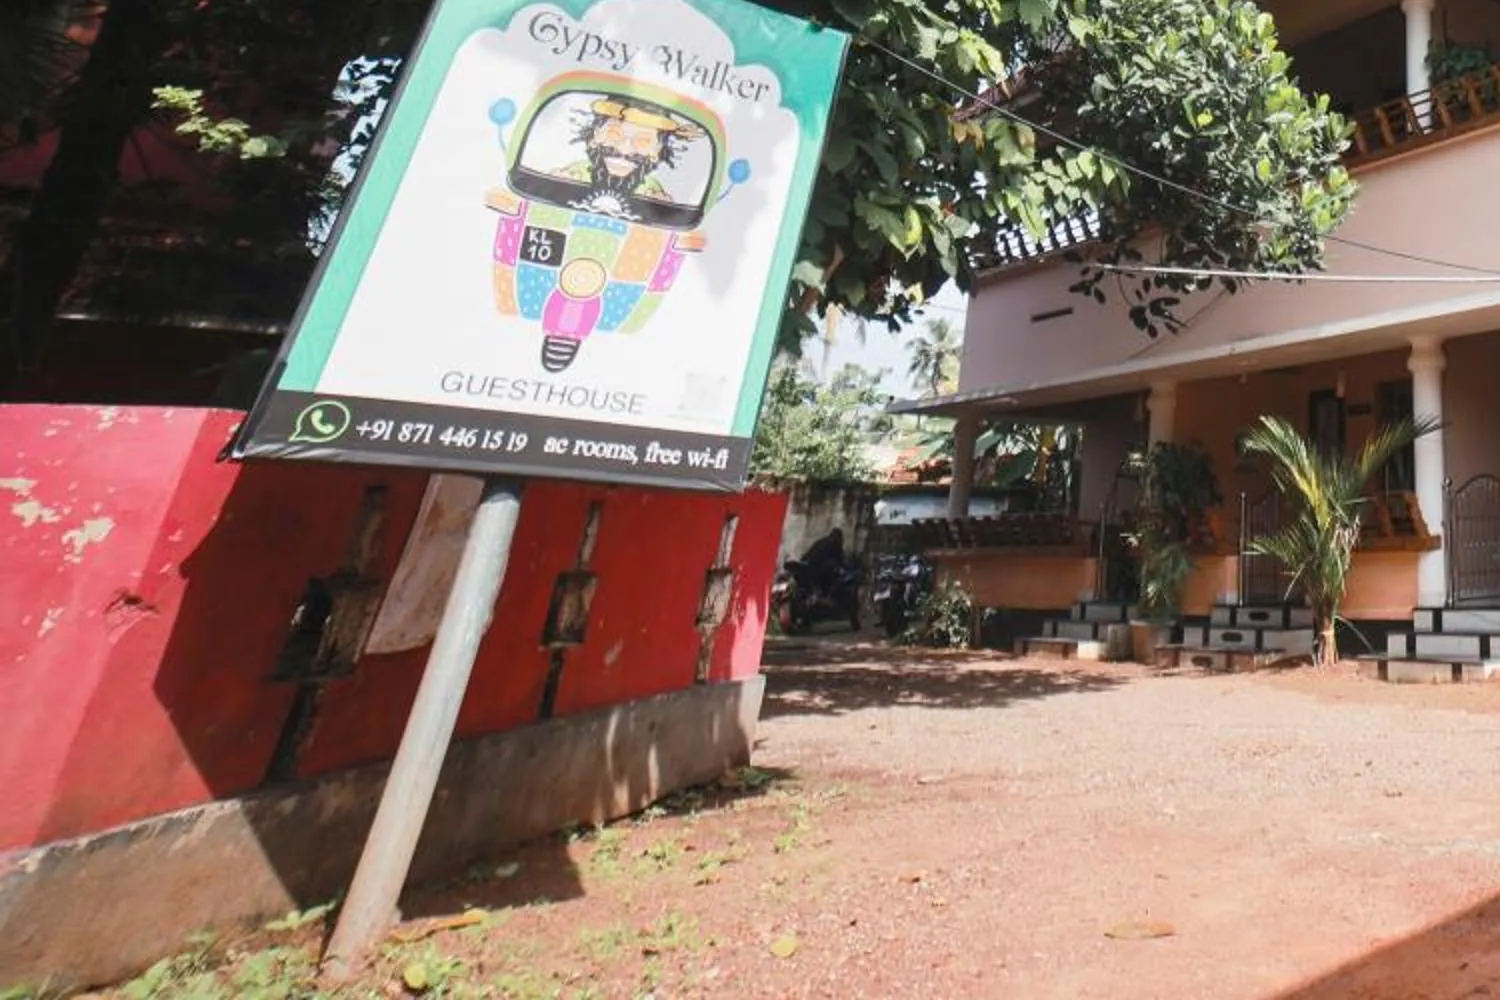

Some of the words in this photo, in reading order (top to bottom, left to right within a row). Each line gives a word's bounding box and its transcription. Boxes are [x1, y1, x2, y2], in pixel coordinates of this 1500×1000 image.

[528, 10, 639, 71] Gypsy
[651, 44, 770, 103] Walker
[528, 245, 551, 261] 10
[529, 229, 552, 244] KL
[440, 370, 649, 415] GUESTHOUSE
[355, 419, 395, 441] +91
[397, 422, 435, 444] 871
[438, 426, 479, 448] 446
[543, 436, 569, 455] ac
[572, 438, 640, 465] rooms,
[643, 440, 683, 466] free
[686, 447, 730, 470] wi-fi
